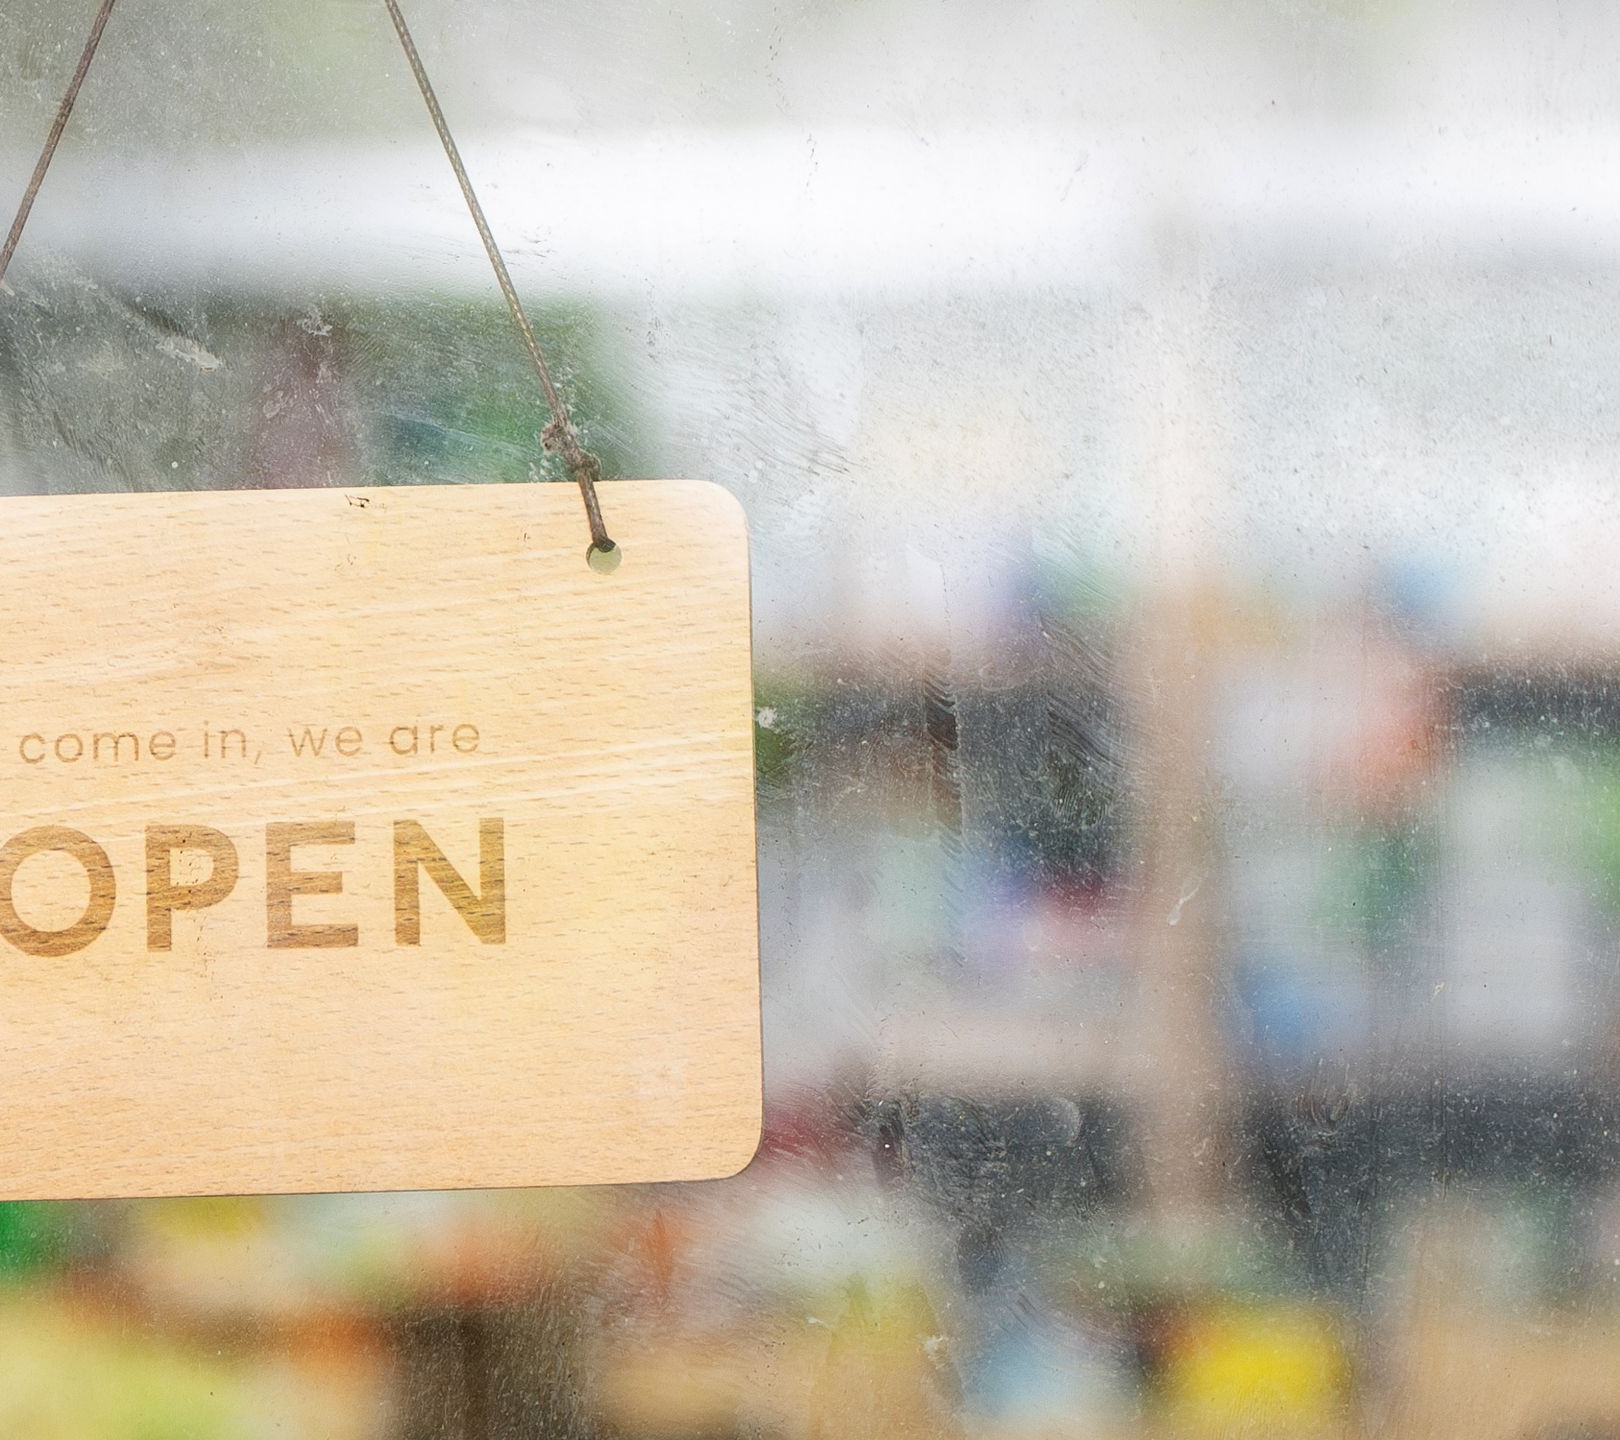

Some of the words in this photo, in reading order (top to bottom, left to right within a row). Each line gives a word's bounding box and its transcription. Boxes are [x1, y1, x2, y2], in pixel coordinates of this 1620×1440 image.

[18, 729, 178, 765] come
[201, 720, 264, 766] in,
[287, 724, 365, 759] we
[387, 721, 482, 757] are
